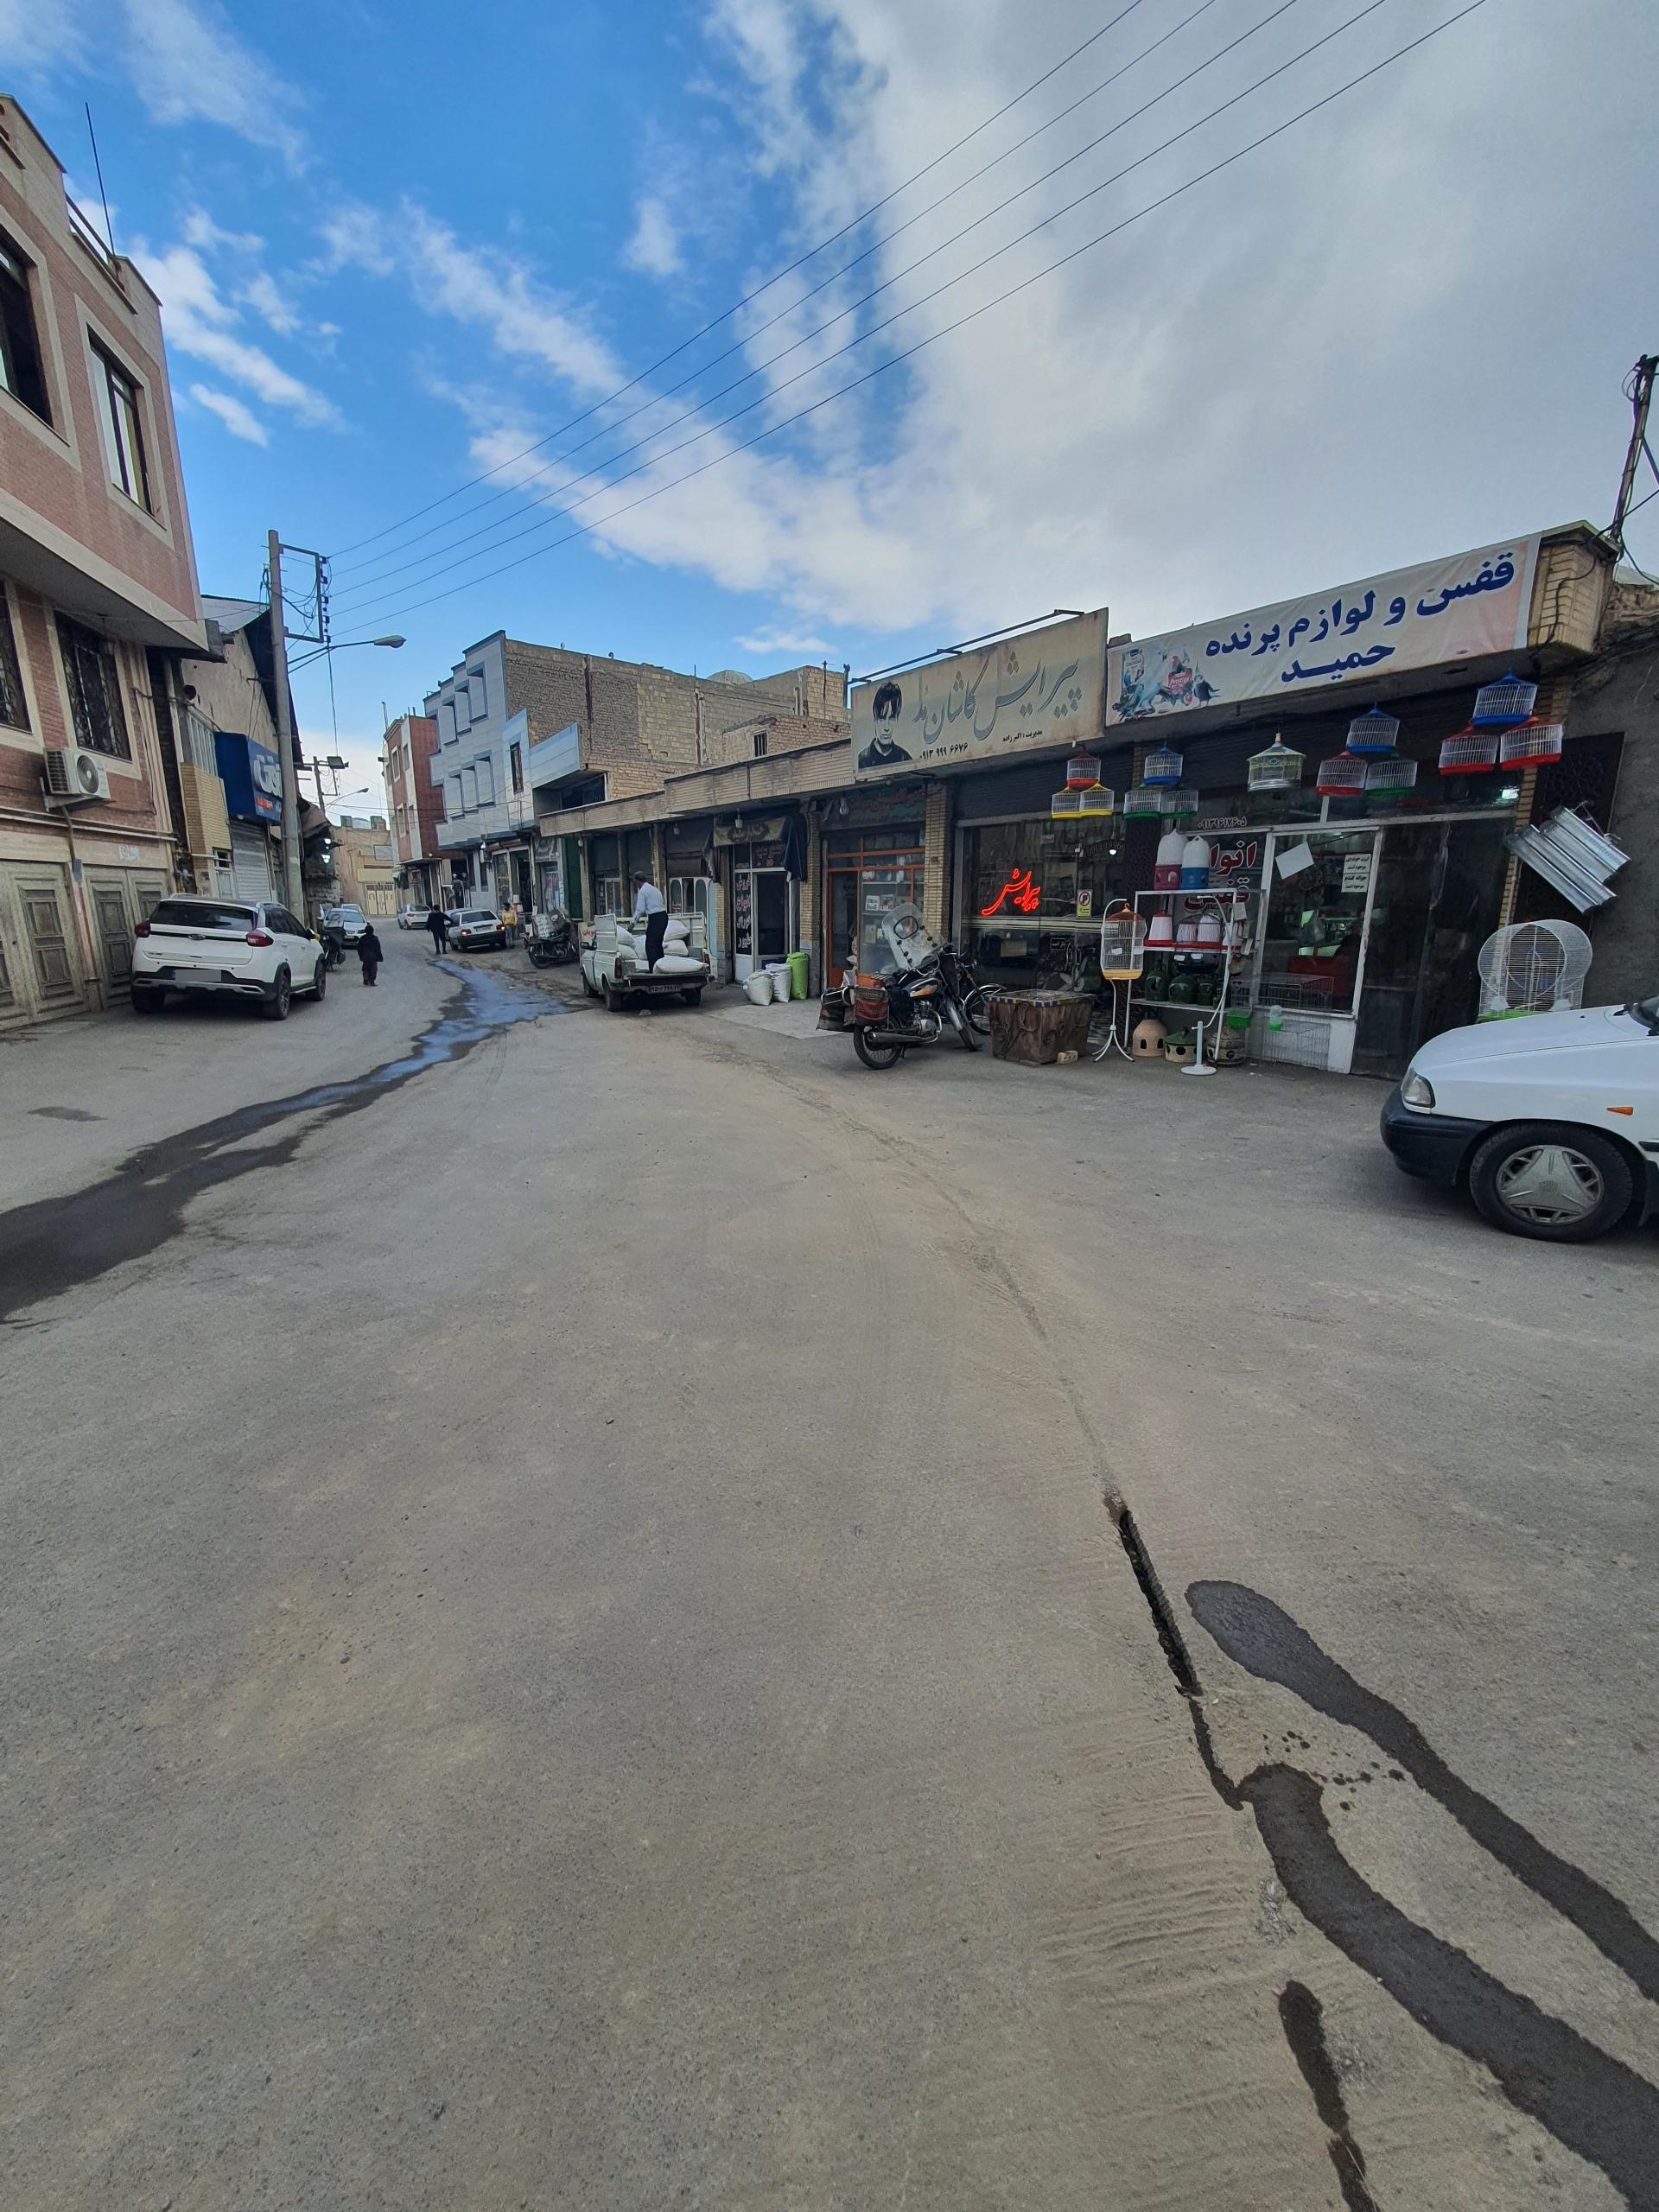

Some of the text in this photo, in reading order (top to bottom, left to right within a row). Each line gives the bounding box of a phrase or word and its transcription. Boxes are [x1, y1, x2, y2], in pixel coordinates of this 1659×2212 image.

[1206, 552, 1515, 657] قفس و لوازم پرنده
[1281, 643, 1395, 683] حمید
[923, 655, 989, 744] کاشان
[974, 651, 1082, 741] پیرایش
[919, 742, 968, 760] ۰۹۱۳ ۹۹۹ ۶۶۷۶
[1210, 840, 1257, 876] انوا
[982, 868, 1041, 915] پیرایش
